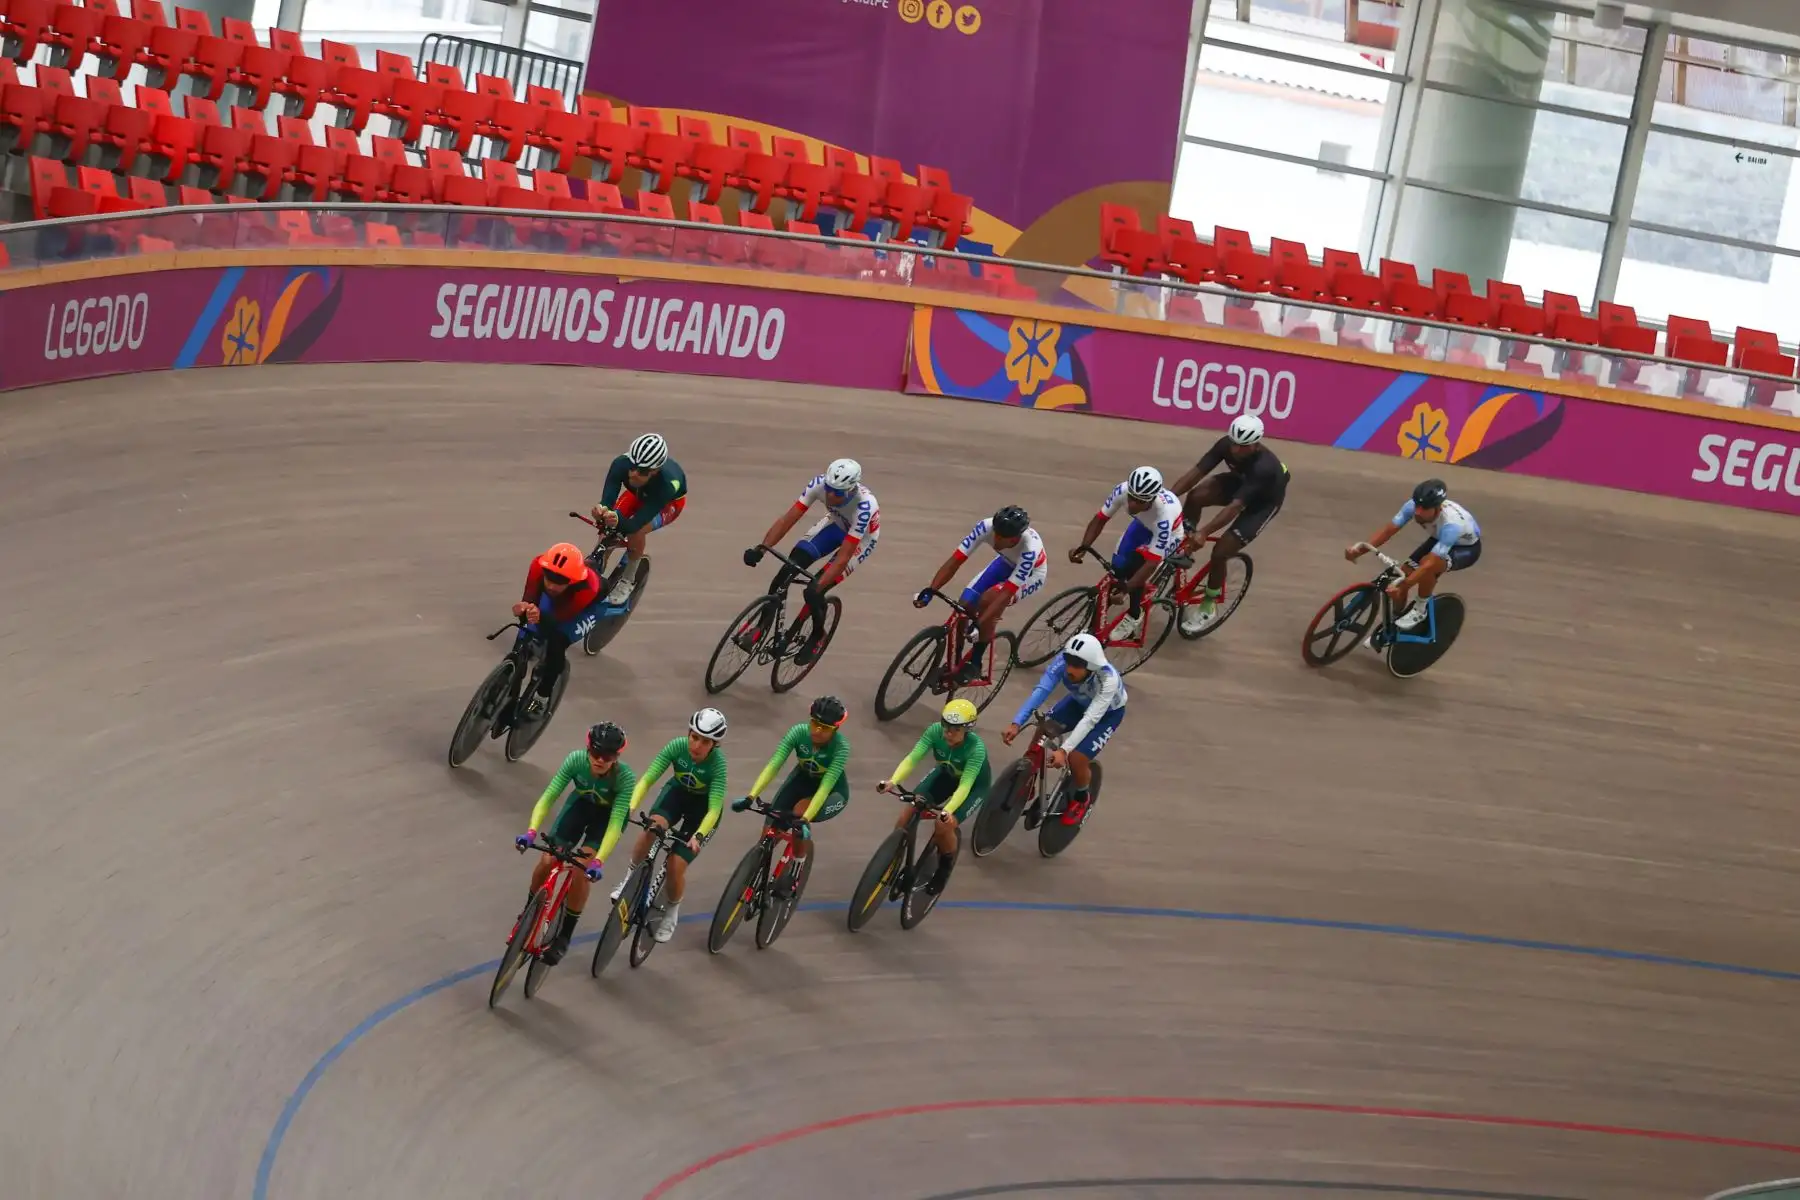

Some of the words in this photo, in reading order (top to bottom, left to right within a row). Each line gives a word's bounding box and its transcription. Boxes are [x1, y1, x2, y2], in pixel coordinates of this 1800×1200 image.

[430, 282, 615, 343] SEGUIMOS
[613, 295, 786, 361] JUGANDO
[1016, 550, 1035, 582] DOM
[1021, 579, 1043, 600] DOM
